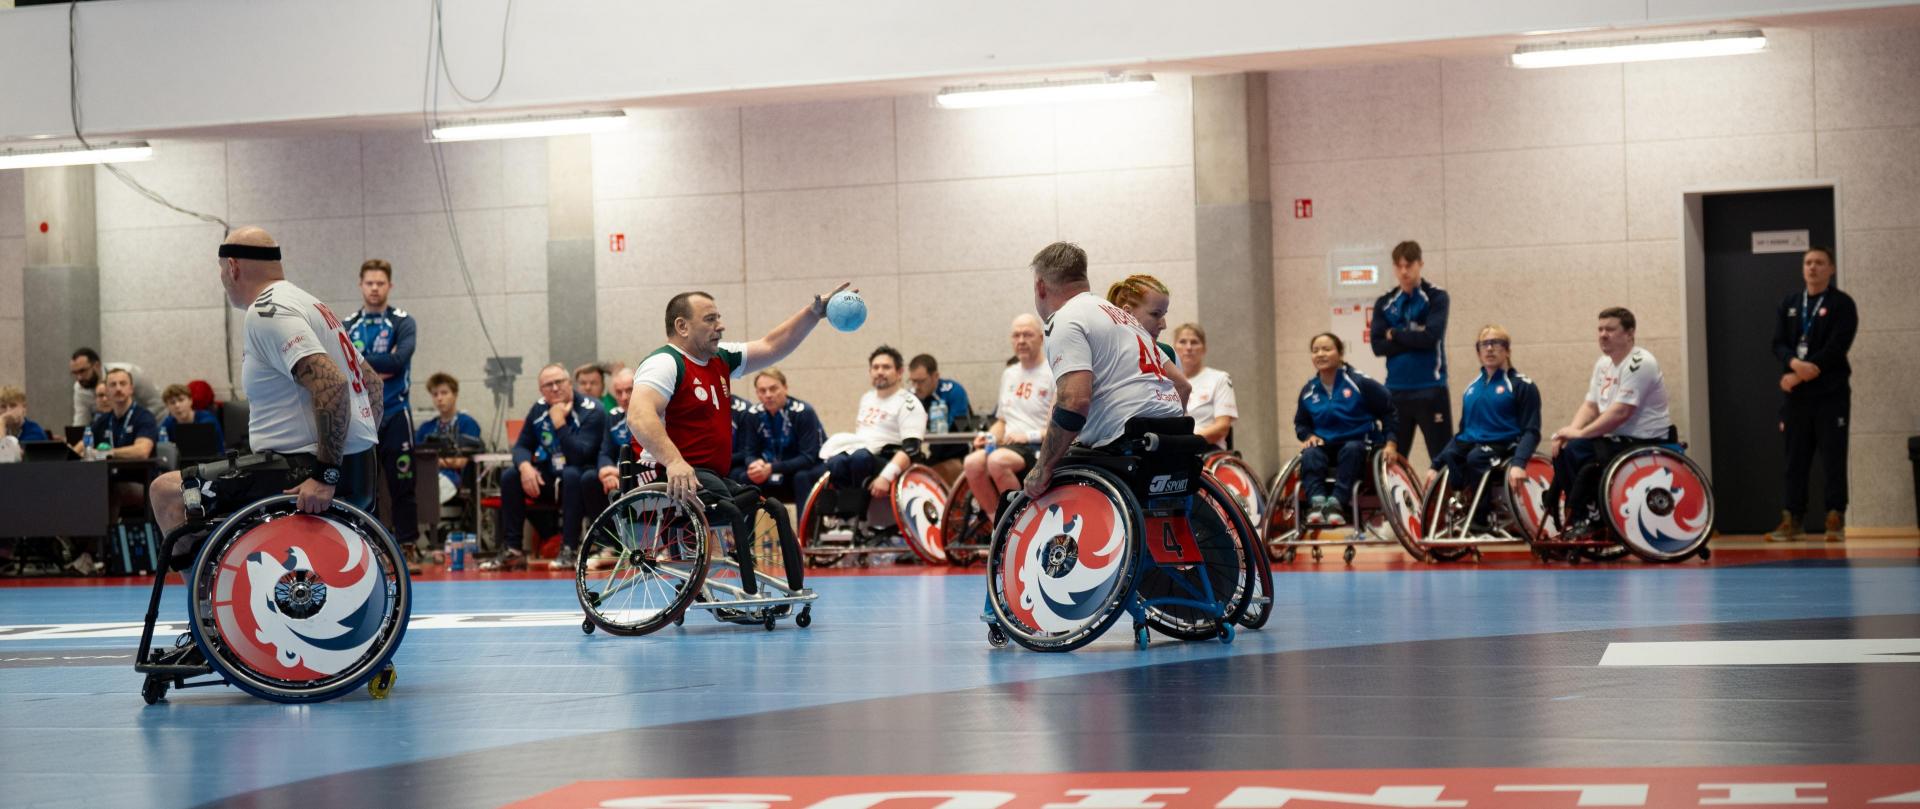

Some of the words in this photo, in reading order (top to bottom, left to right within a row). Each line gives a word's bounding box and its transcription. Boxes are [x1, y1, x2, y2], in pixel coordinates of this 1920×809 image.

[710, 385, 720, 410] 4
[1015, 383, 1032, 400] 46
[1165, 479, 1189, 492] SPORT
[1163, 521, 1183, 559] 4
